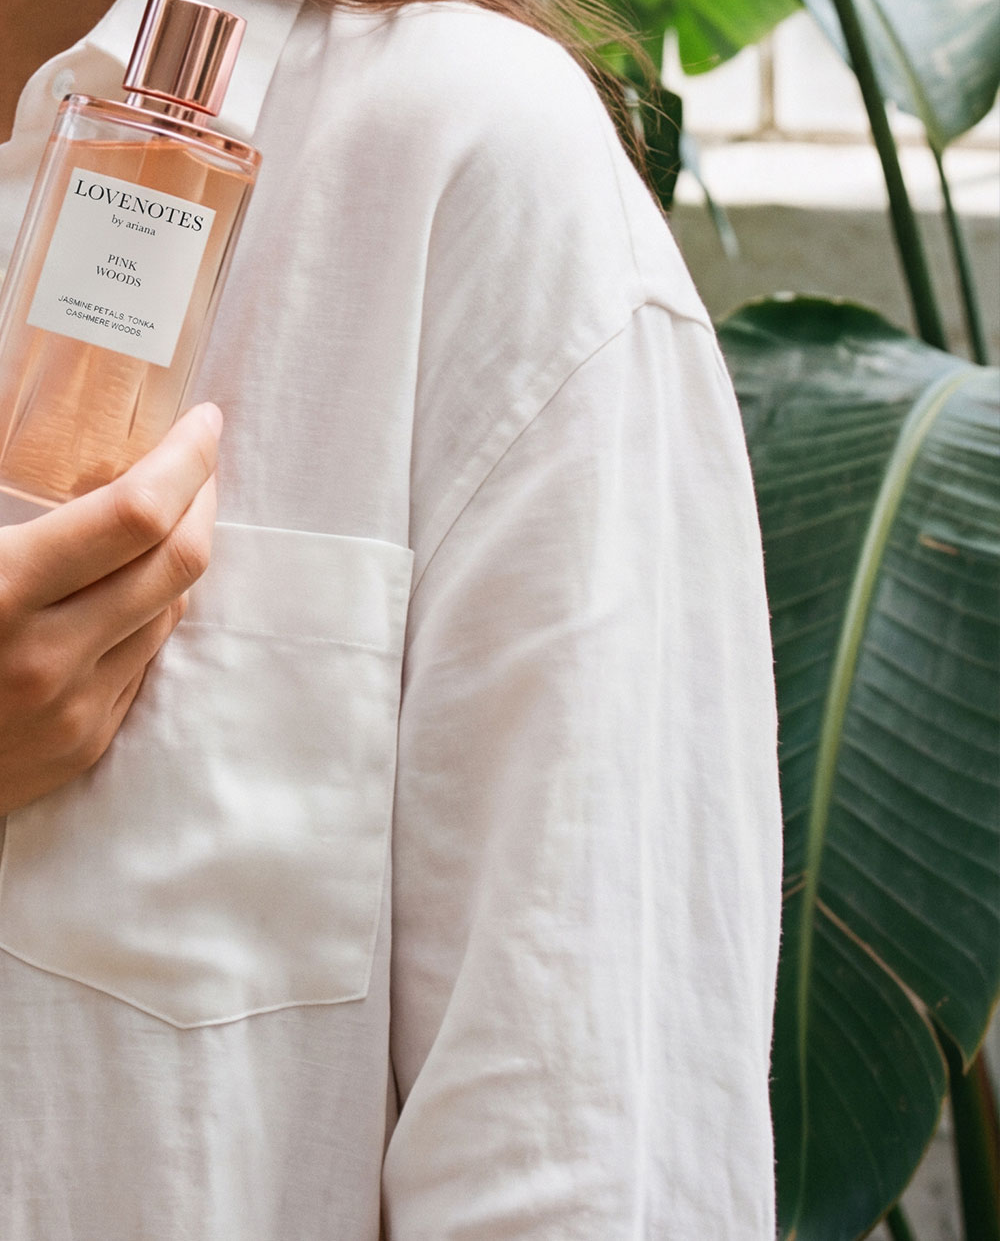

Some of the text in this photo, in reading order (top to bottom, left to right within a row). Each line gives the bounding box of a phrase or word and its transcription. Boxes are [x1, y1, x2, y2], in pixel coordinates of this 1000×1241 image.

[74, 179, 204, 232] LOVENOTES
[111, 214, 156, 236] by ariana
[107, 254, 138, 271] PINK
[96, 265, 142, 287] WOODS
[58, 294, 92, 311] JASMINE
[127, 315, 155, 329] TONKA
[65, 308, 143, 338] CASHMERE WOODS.
